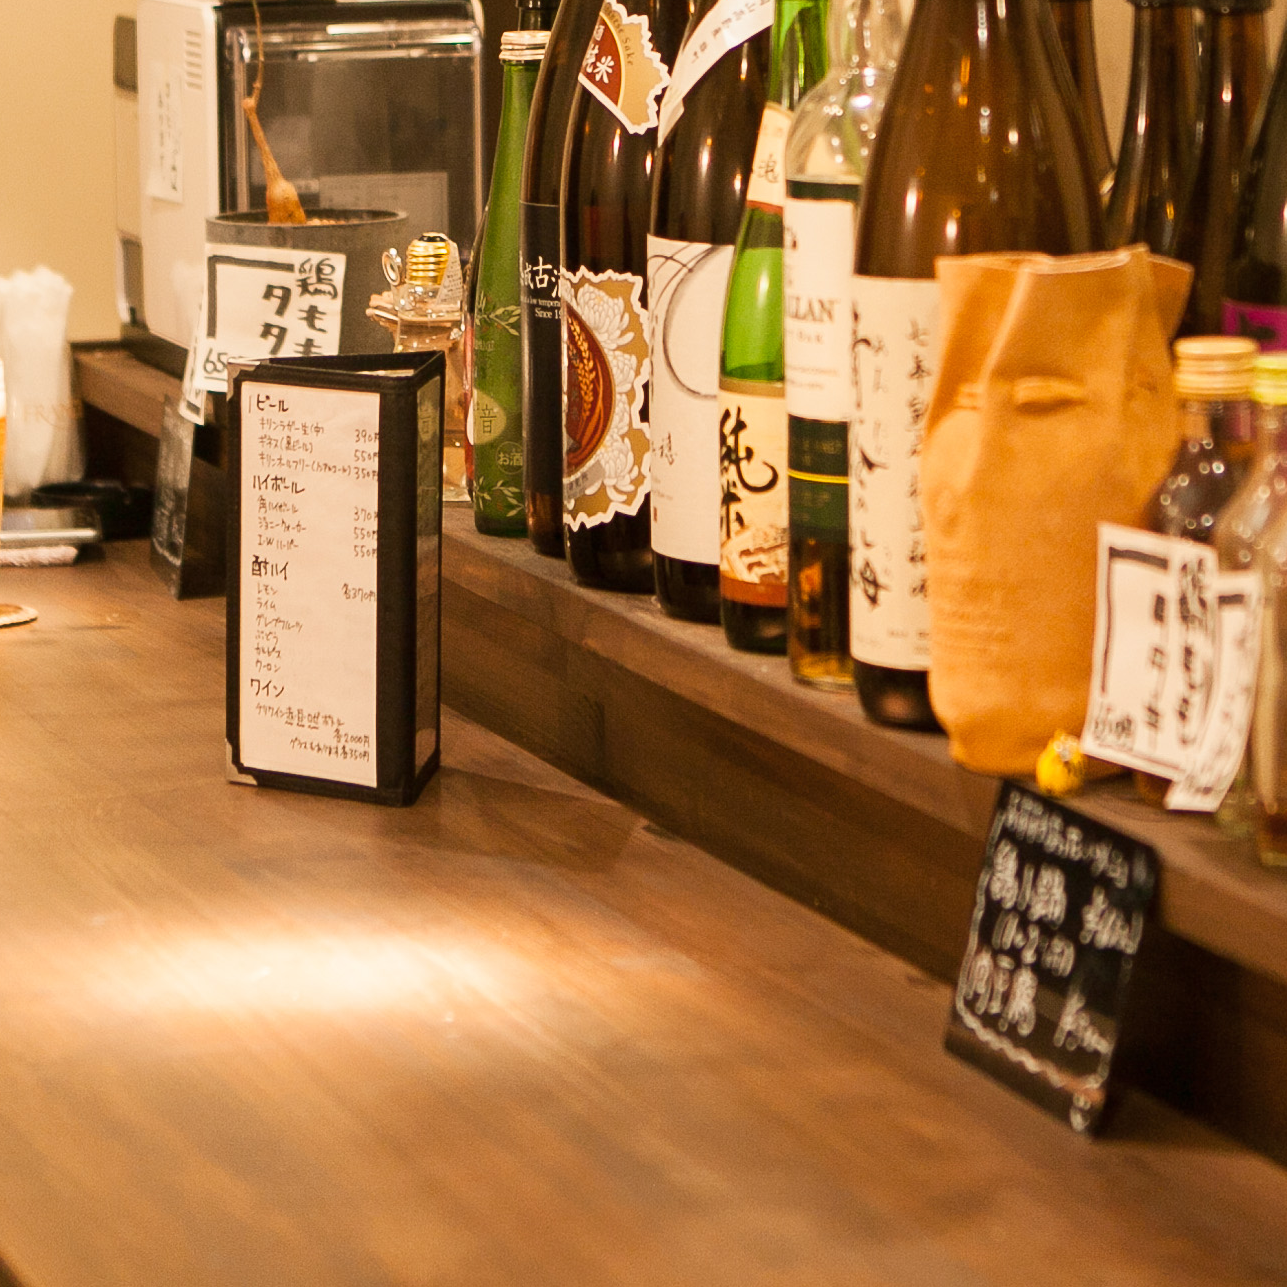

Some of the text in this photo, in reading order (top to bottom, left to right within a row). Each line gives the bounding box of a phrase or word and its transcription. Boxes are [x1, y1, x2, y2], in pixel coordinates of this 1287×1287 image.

[535, 307, 553, 320] Since
[256, 394, 289, 412] ビール
[253, 474, 305, 493] ハイボール
[252, 554, 289, 581] 酎ハイ
[257, 582, 278, 596] レモン
[256, 597, 277, 611] ライム
[250, 678, 285, 697] ワイン
